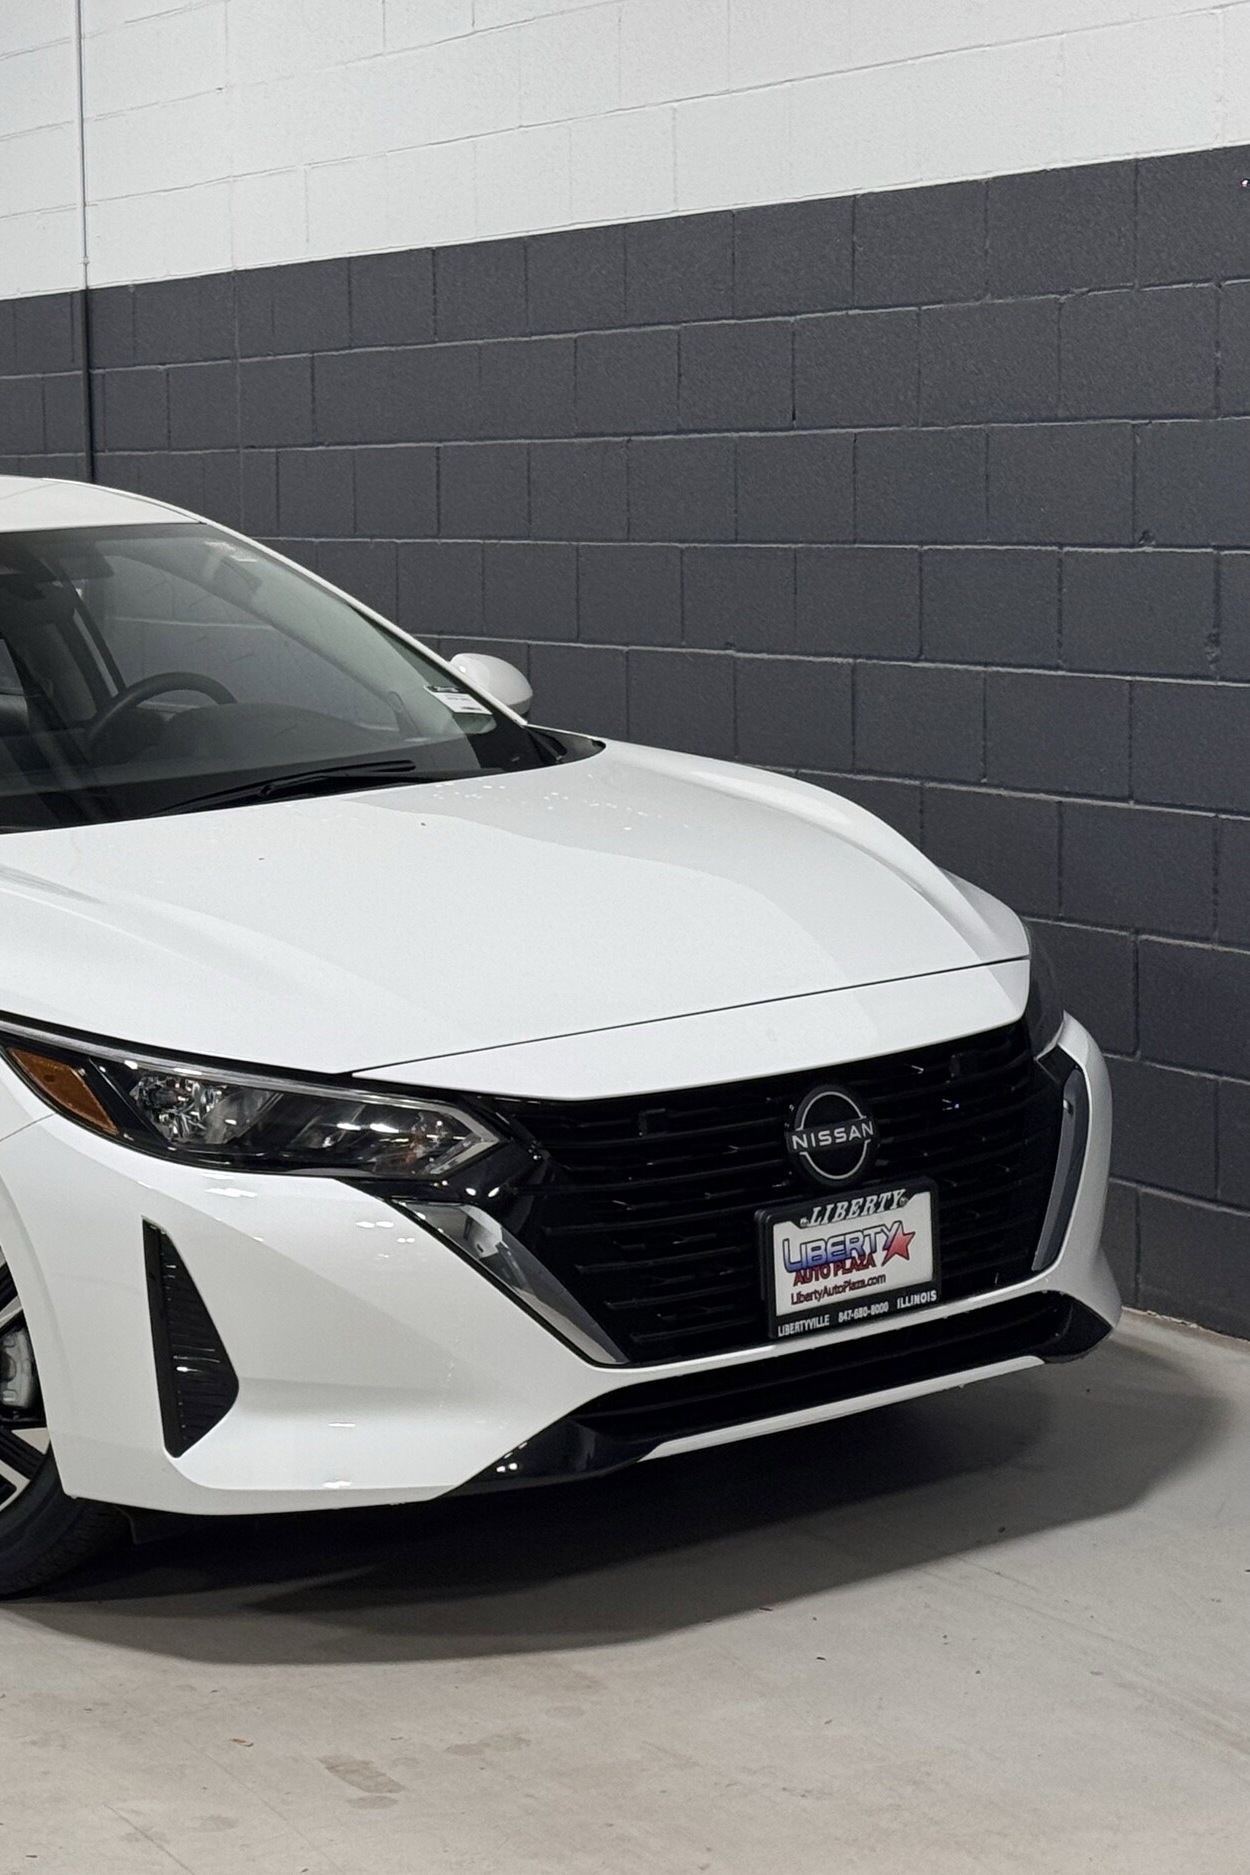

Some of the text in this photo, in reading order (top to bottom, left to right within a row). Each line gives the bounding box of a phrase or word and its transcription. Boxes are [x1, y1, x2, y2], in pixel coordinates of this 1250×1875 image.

[792, 1120, 874, 1150] NISSAN
[809, 1188, 906, 1227] LIBERTY
[783, 1220, 902, 1273] LIBERTY
[793, 1253, 876, 1287] AUTO PLAZA
[791, 1273, 886, 1306] LibertyAutoPlaza.com
[777, 1289, 937, 1337] LIBERTYVILLE 847-680-8000 ILLINOIS
